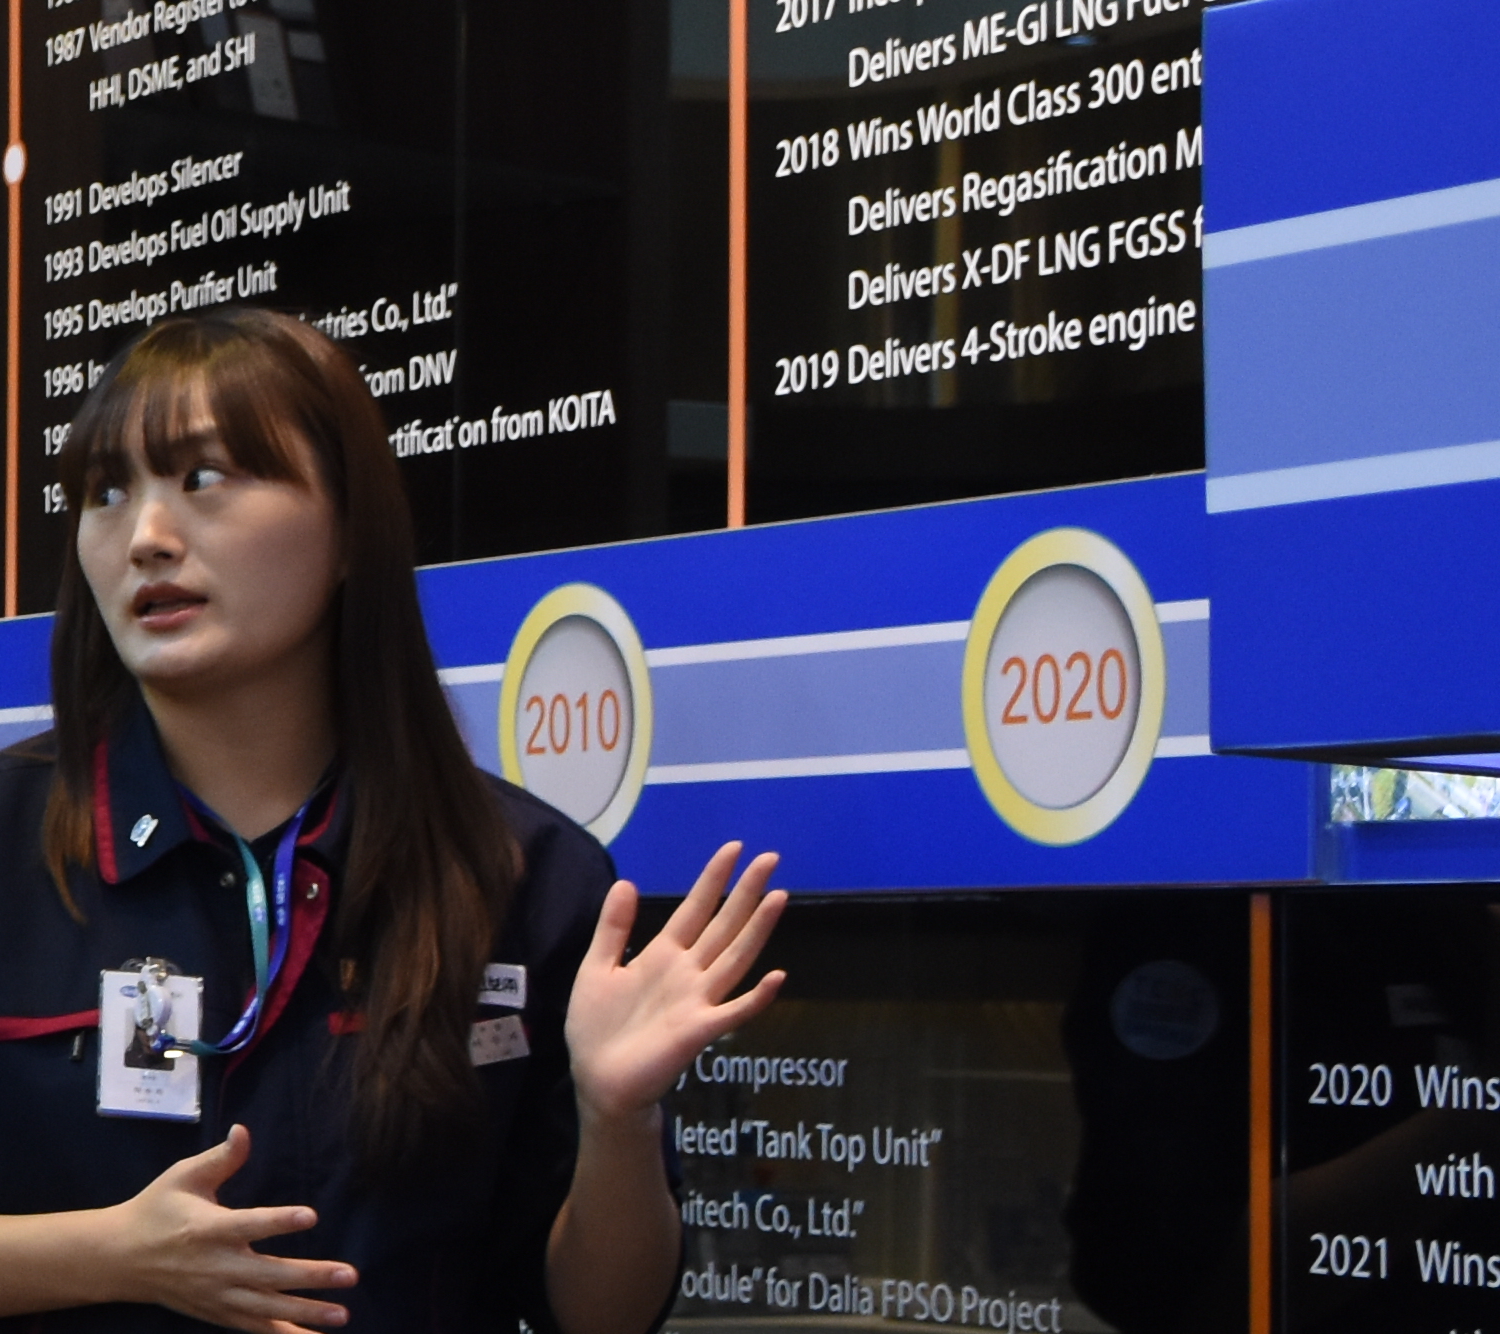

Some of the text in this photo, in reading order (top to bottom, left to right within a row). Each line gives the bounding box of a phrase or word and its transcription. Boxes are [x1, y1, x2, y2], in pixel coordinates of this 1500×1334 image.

[45, 26, 86, 67] 1987
[88, 8, 152, 53] Vendor
[89, 31, 256, 113] HHI, DSME, and SHI
[775, 58, 1145, 179] 2018 Wins World Class 300
[44, 151, 243, 226] 1991 Develops Silencer
[848, 140, 1167, 237] Delivers Regasification
[44, 179, 351, 283] 1993 Develops Fuel Oil Supply Unit
[848, 209, 1186, 311] Delivers X-DF LNG FGSS
[44, 260, 278, 341] 1995 Develops Purifier Unit
[43, 361, 84, 399] 1996
[774, 294, 1196, 397] 2019 Delivers 4-Stroke engine
[524, 688, 621, 756] 2010
[1001, 647, 1128, 726] 2020
[695, 1044, 848, 1094] Compressor
[1308, 1062, 1392, 1108] 2020
[740, 1119, 943, 1173] “Tank Top Unit”
[1414, 1151, 1494, 1199] with
[1309, 1232, 1387, 1279] 2021
[765, 1265, 803, 1308] for
[808, 1271, 874, 1316] Dalia
[880, 1278, 955, 1323] FPSO
